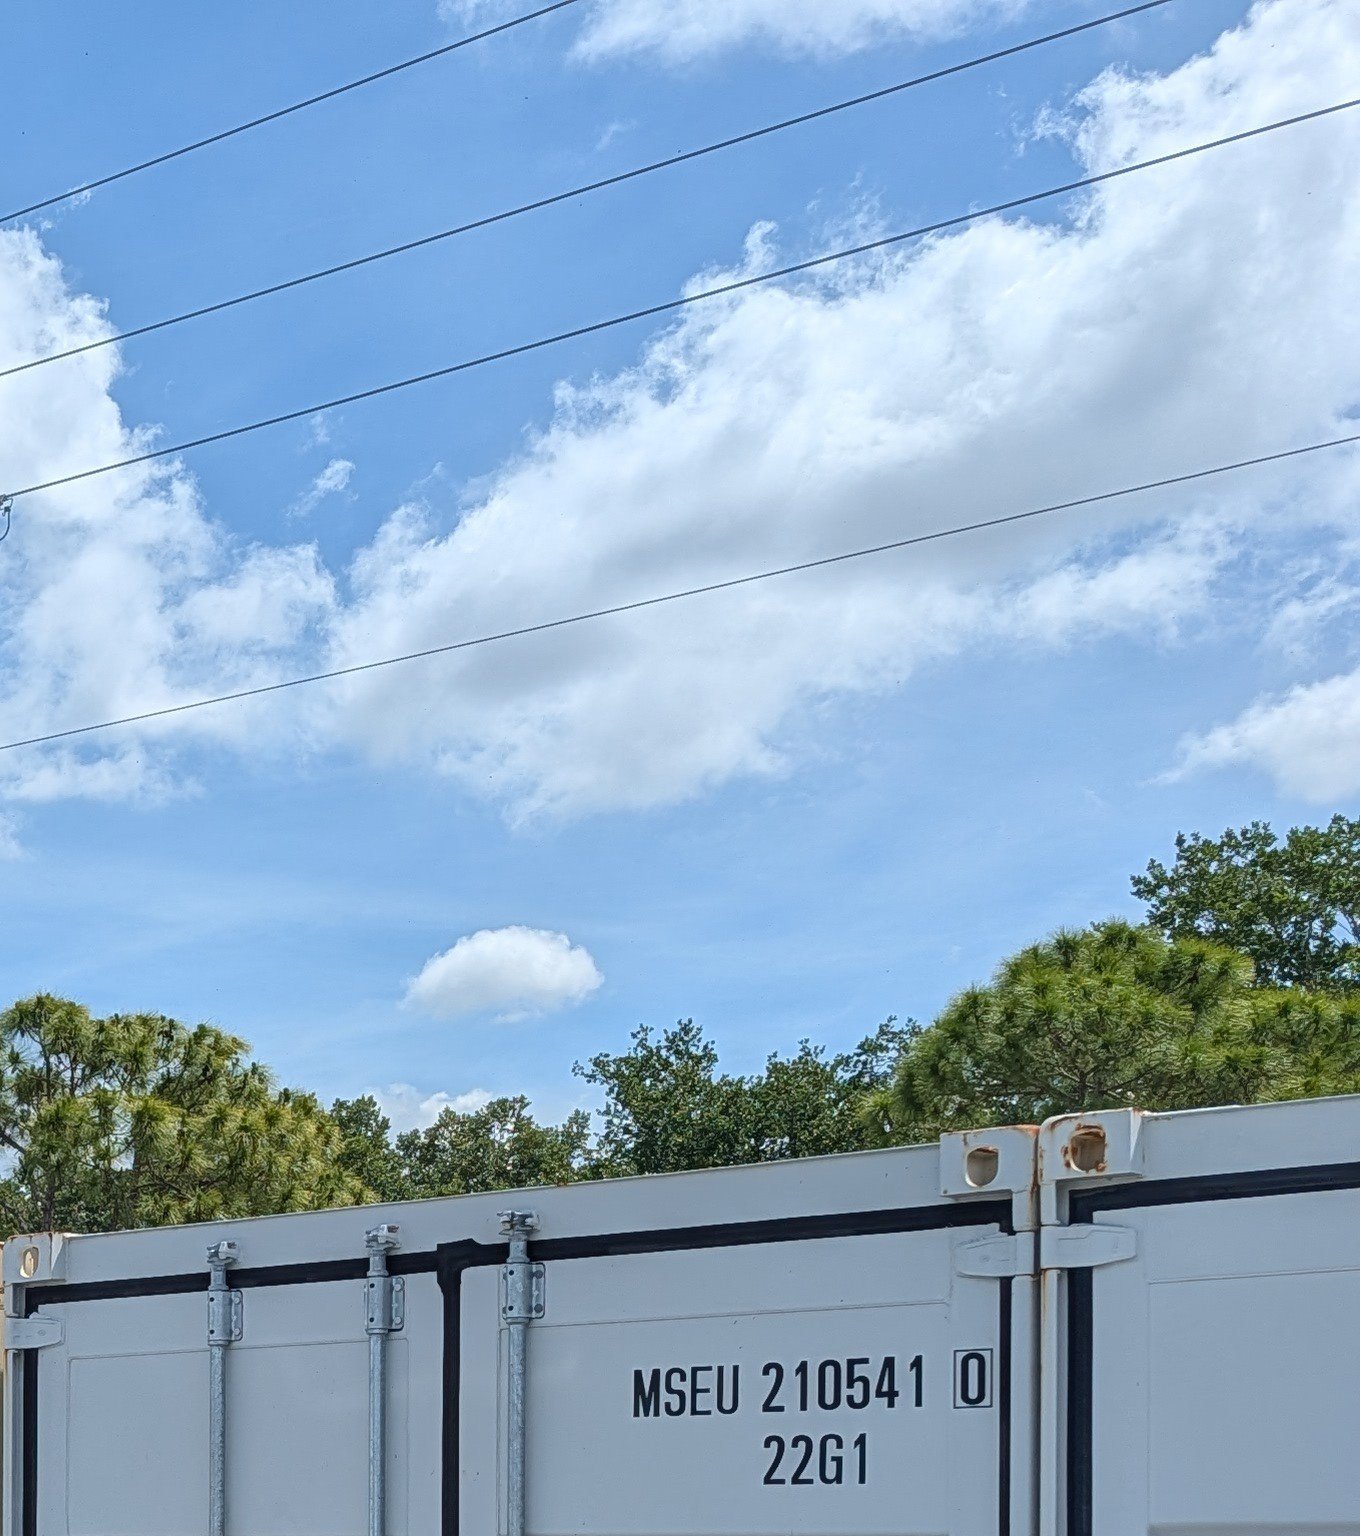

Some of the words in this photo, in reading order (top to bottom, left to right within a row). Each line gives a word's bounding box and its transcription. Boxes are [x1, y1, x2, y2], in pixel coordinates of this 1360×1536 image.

[632, 1364, 740, 1418] MSEU
[761, 1354, 924, 1413] 210541
[956, 1350, 990, 1408] 0
[762, 1432, 868, 1486] 22G1
